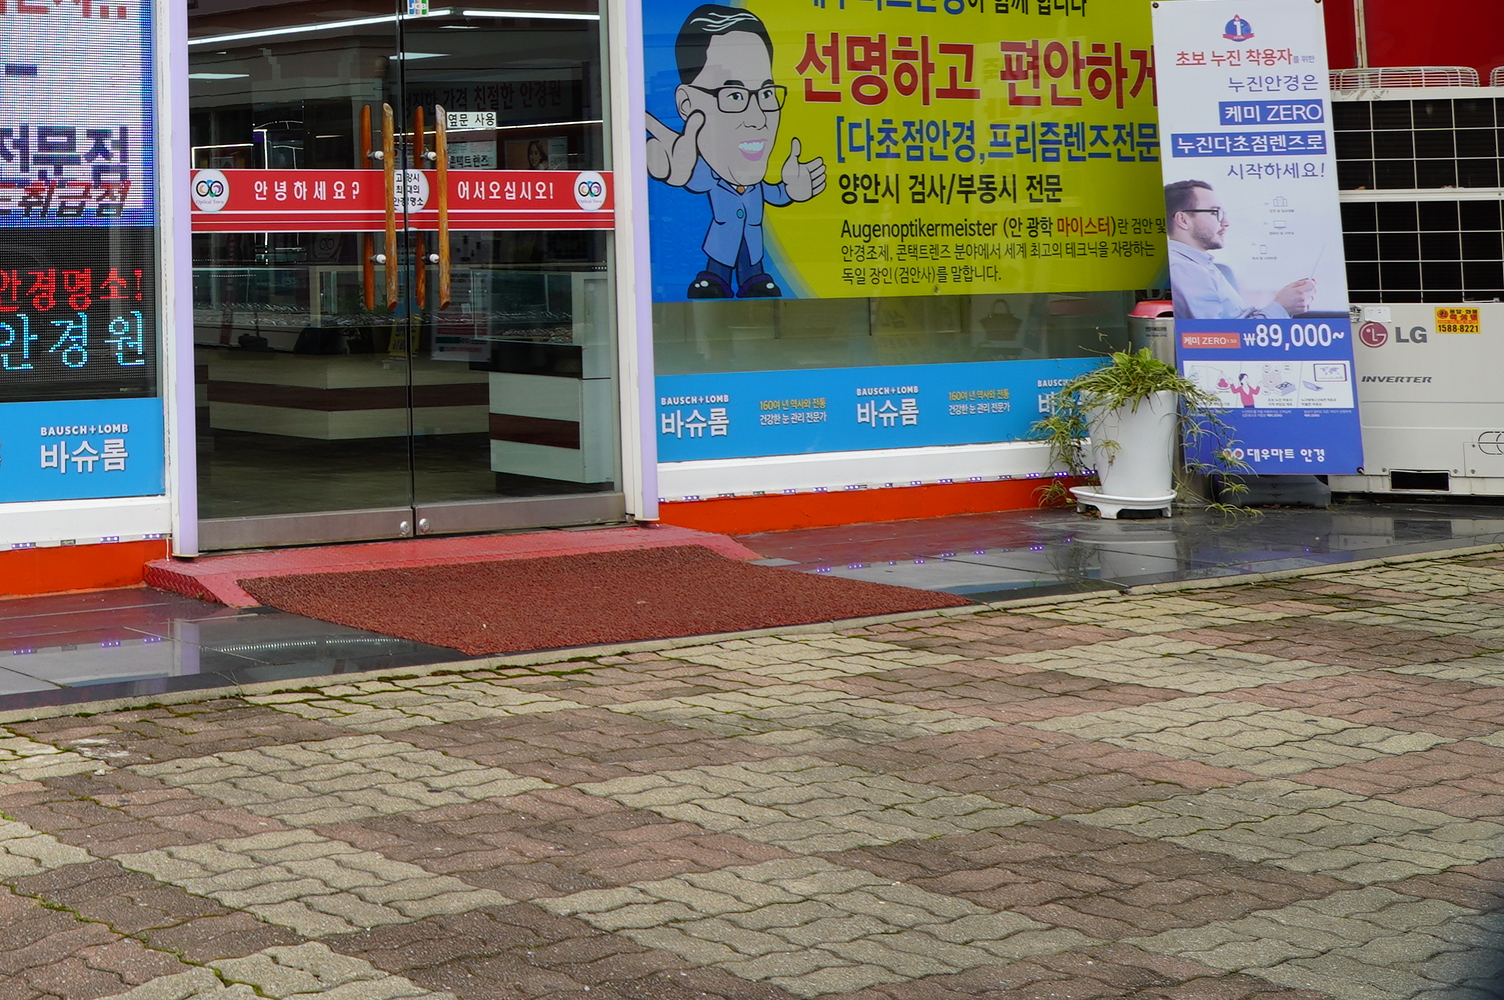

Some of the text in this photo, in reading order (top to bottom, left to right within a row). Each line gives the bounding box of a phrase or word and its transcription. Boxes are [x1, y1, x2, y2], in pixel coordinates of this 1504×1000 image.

[1175, 51, 1206, 66] 초보
[1210, 49, 1241, 67] 누진
[795, 32, 981, 106] 선명하고
[1228, 74, 1319, 92] 누진안경은
[448, 113, 494, 127] 옆문 사용
[1225, 104, 1322, 122] 케미 ZERO
[1177, 134, 1325, 154] 누진다초점렌즈로
[1227, 162, 1325, 180] 시작하세요!
[254, 180, 360, 201] 안녕하세요?
[457, 180, 554, 200] 어서오십시오!
[839, 173, 1063, 205] 양안시 검사/부동시 전문
[841, 218, 997, 243] Augenoptikermeister
[1026, 217, 1053, 238] 광학
[1131, 218, 1153, 234] 검안
[841, 241, 1155, 262] 안경조제, 콘택트렌즈 분야에서 세계 최고의 테크닉을 자랑하는
[842, 267, 866, 285] 독일
[951, 265, 1001, 283] 말합니다.
[1183, 336, 1200, 345] 케미
[1201, 337, 1227, 345] ZERO
[1395, 326, 1427, 344] LG
[1361, 376, 1432, 384] INVERTER
[661, 408, 730, 438] 바슈롬
[856, 397, 920, 429] 바슈롬
[39, 438, 129, 474] 바슈롬
[1246, 448, 1325, 463] 대우마트 안경
